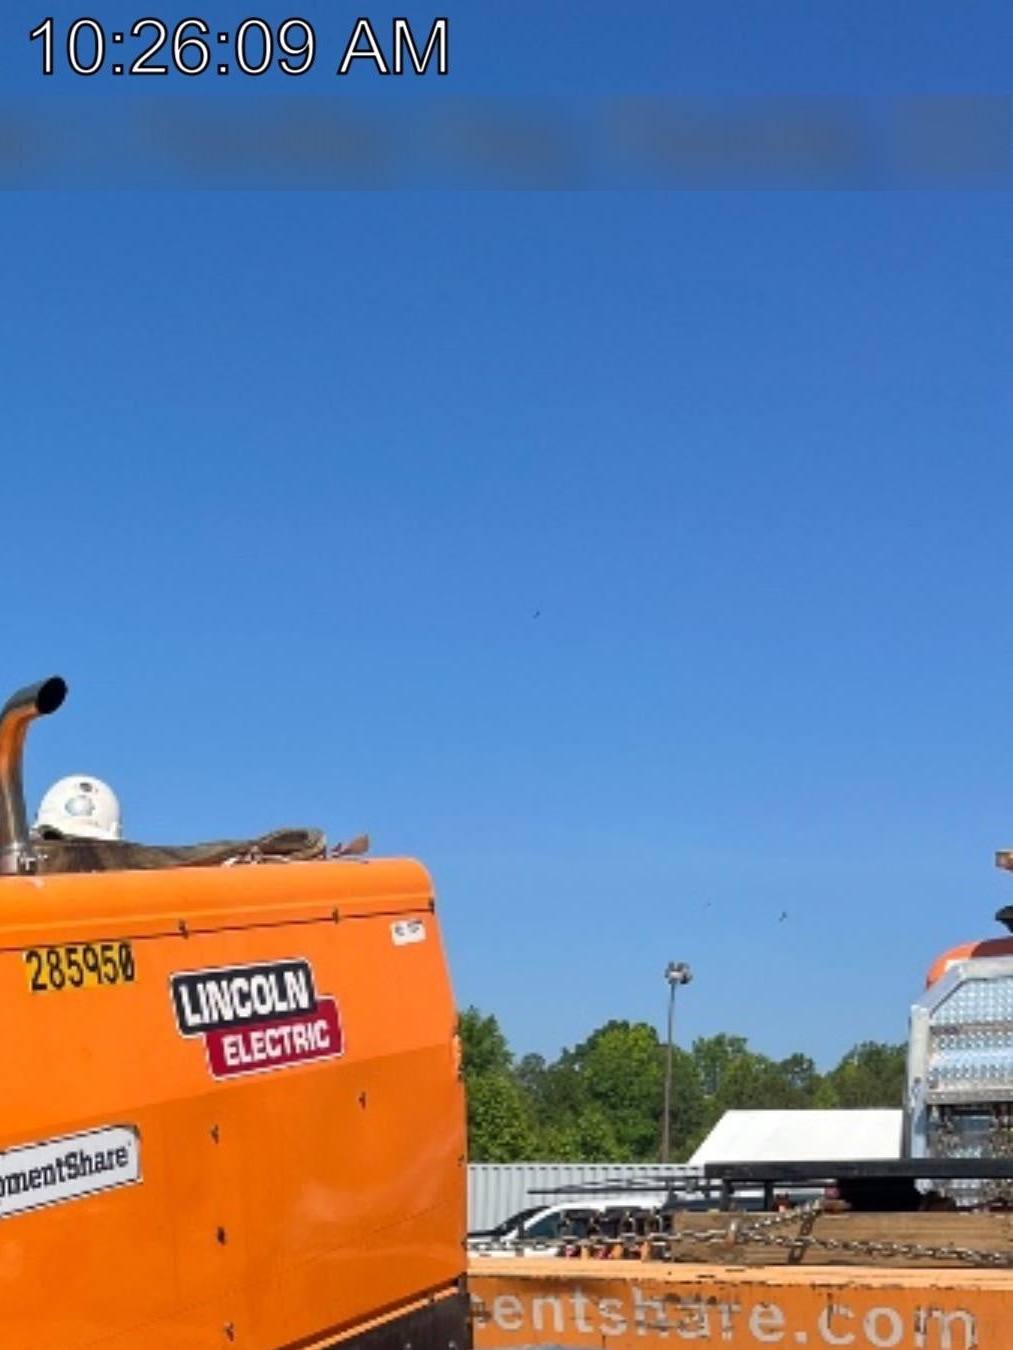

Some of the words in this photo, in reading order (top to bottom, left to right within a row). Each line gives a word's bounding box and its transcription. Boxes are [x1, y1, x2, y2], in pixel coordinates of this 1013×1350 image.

[25, 941, 135, 992] 285950
[177, 969, 310, 1028] LINCOLN
[222, 1018, 331, 1067] ELECTRIC
[472, 1286, 979, 1350] entshare.com
